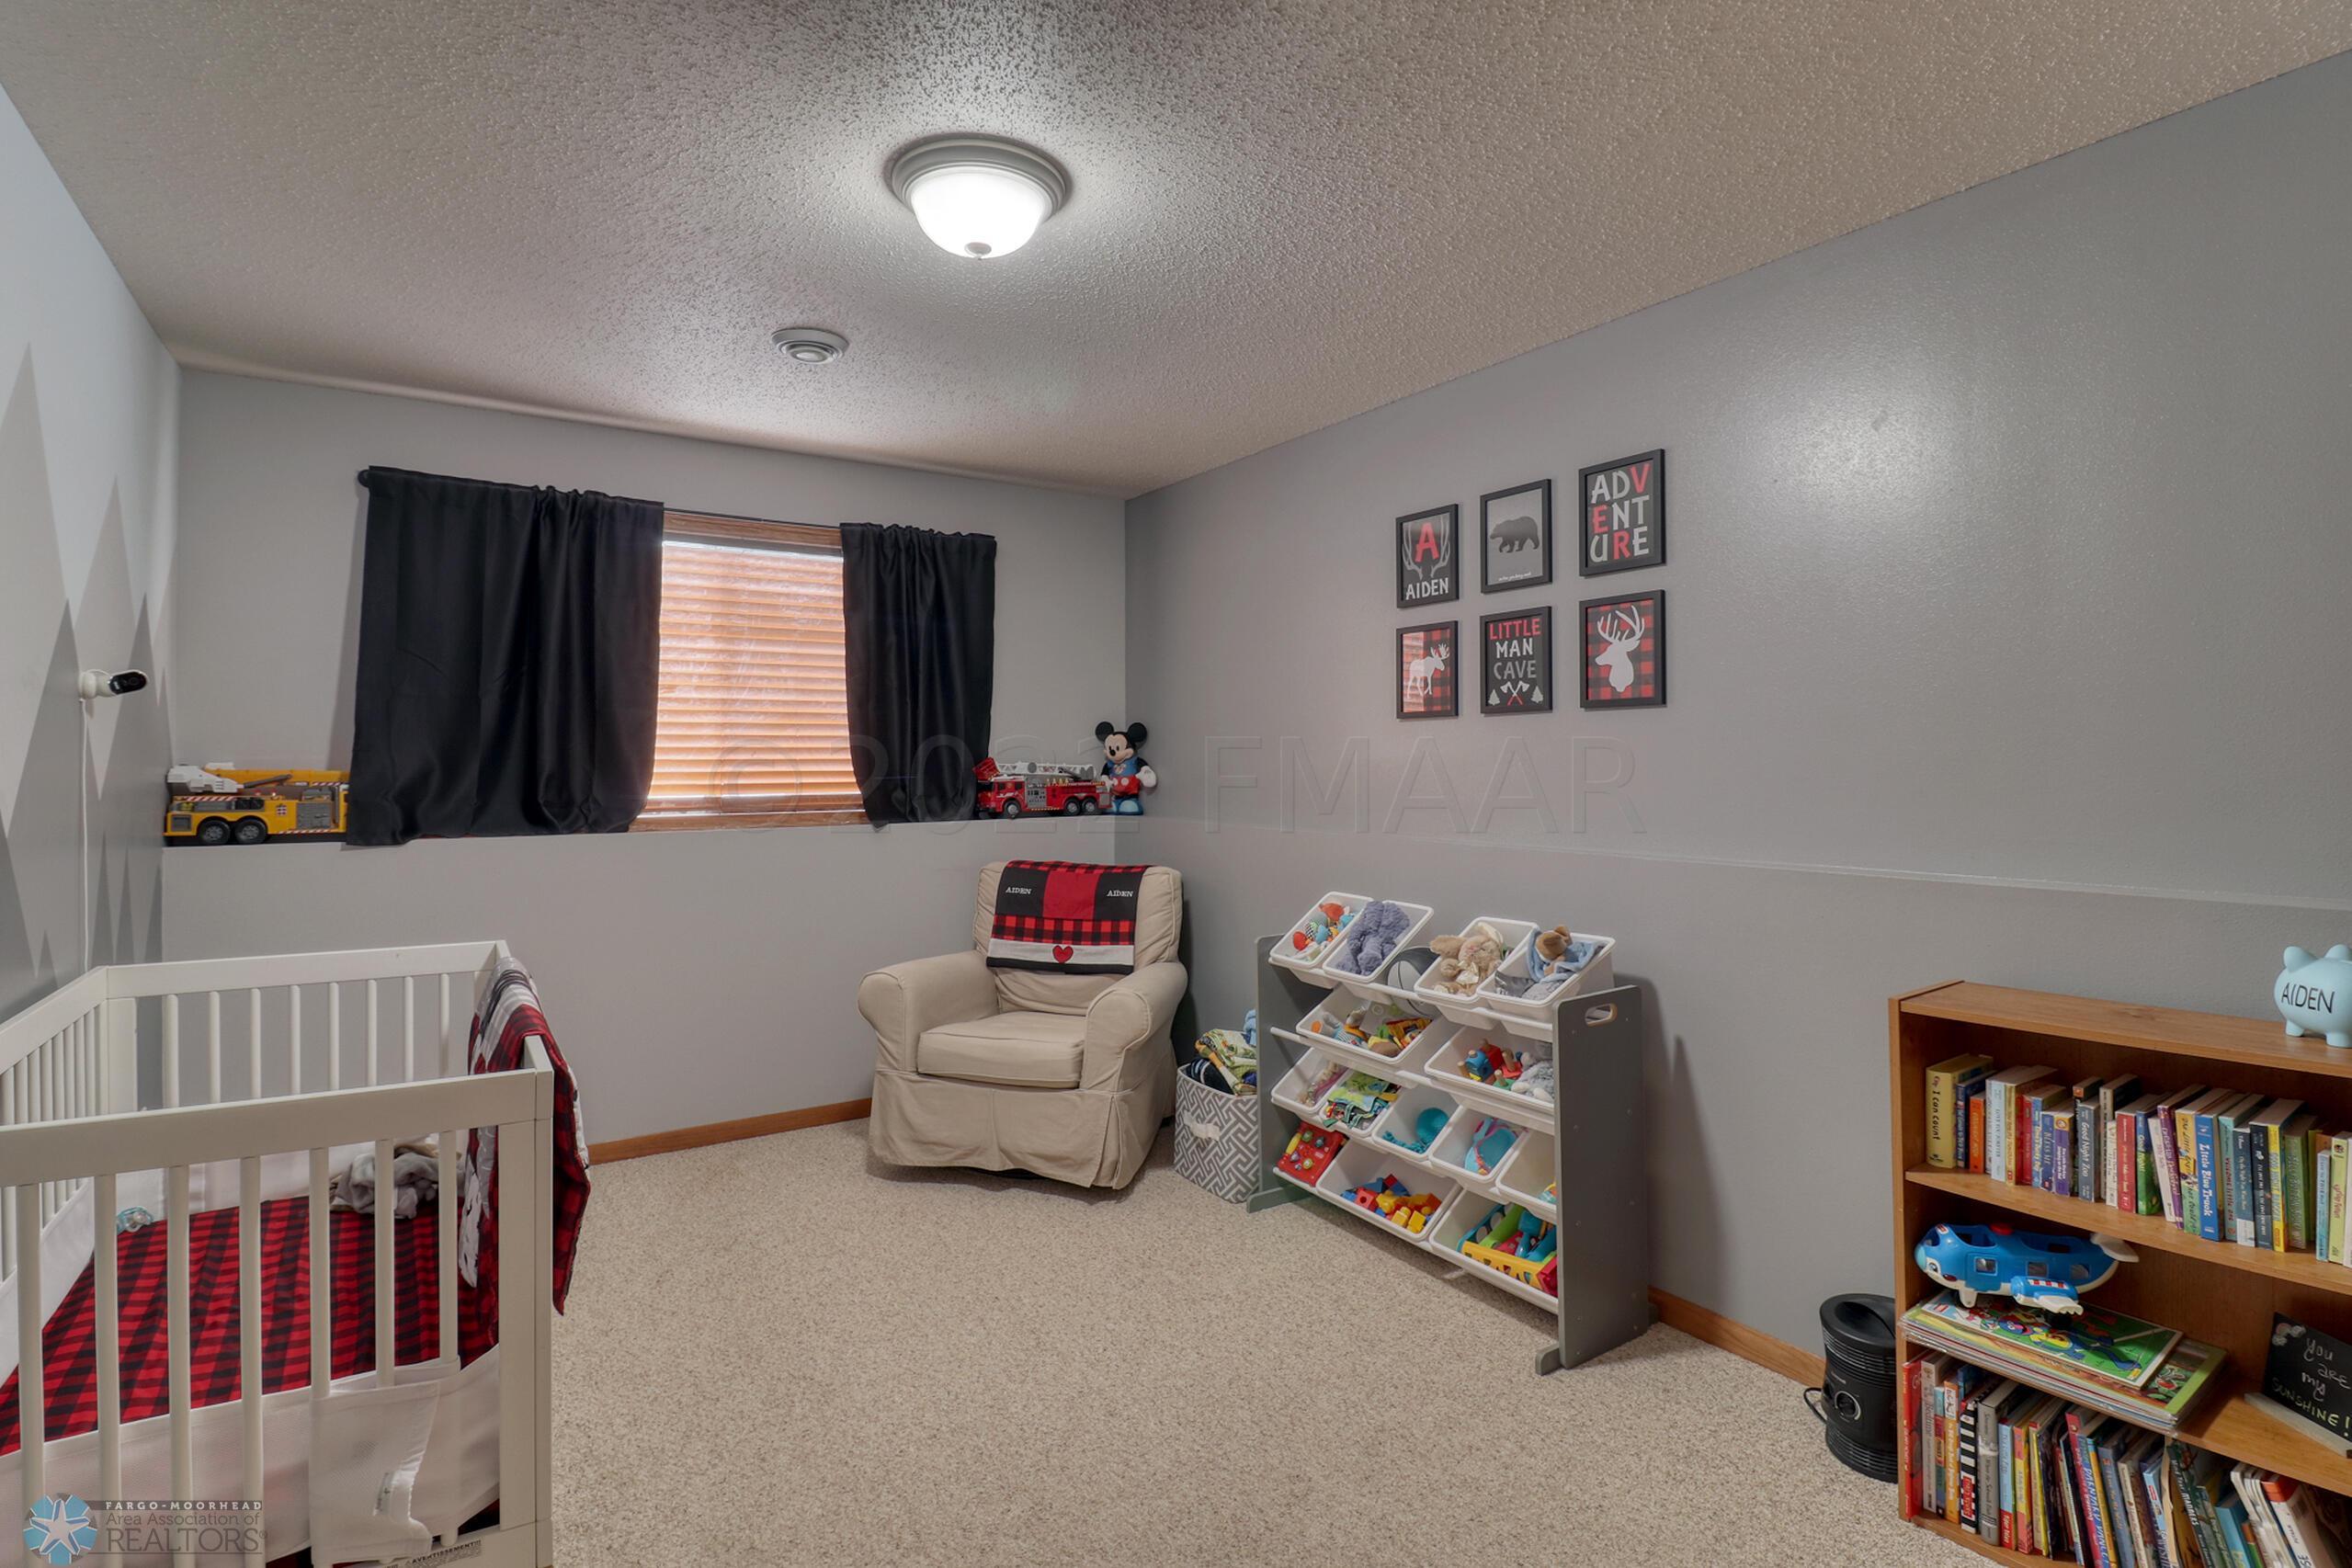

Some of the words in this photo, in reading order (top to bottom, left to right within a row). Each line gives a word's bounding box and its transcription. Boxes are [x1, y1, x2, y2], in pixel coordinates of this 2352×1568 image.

[1591, 463, 1651, 504] ADV
[1592, 494, 1650, 534] ENT
[1415, 522, 1440, 562] A
[1590, 526, 1650, 563] URE
[1405, 577, 1449, 600] AIDEN
[1489, 618, 1542, 641] LITTLE
[1495, 638, 1533, 659] MAN
[1494, 660, 1537, 680] CAVE
[1006, 887, 1031, 895] AIDEN
[1107, 890, 1133, 898] AIDEN
[2281, 983, 2335, 1014] AIDEN
[1932, 1097, 1940, 1113] can
[1932, 1116, 1941, 1141] count
[2081, 1121, 2090, 1140] Good
[2080, 1141, 2090, 1161] Night
[2199, 1143, 2211, 1167] Little
[2201, 1170, 2212, 1188] Blue
[2203, 1189, 2213, 1216] Truck
